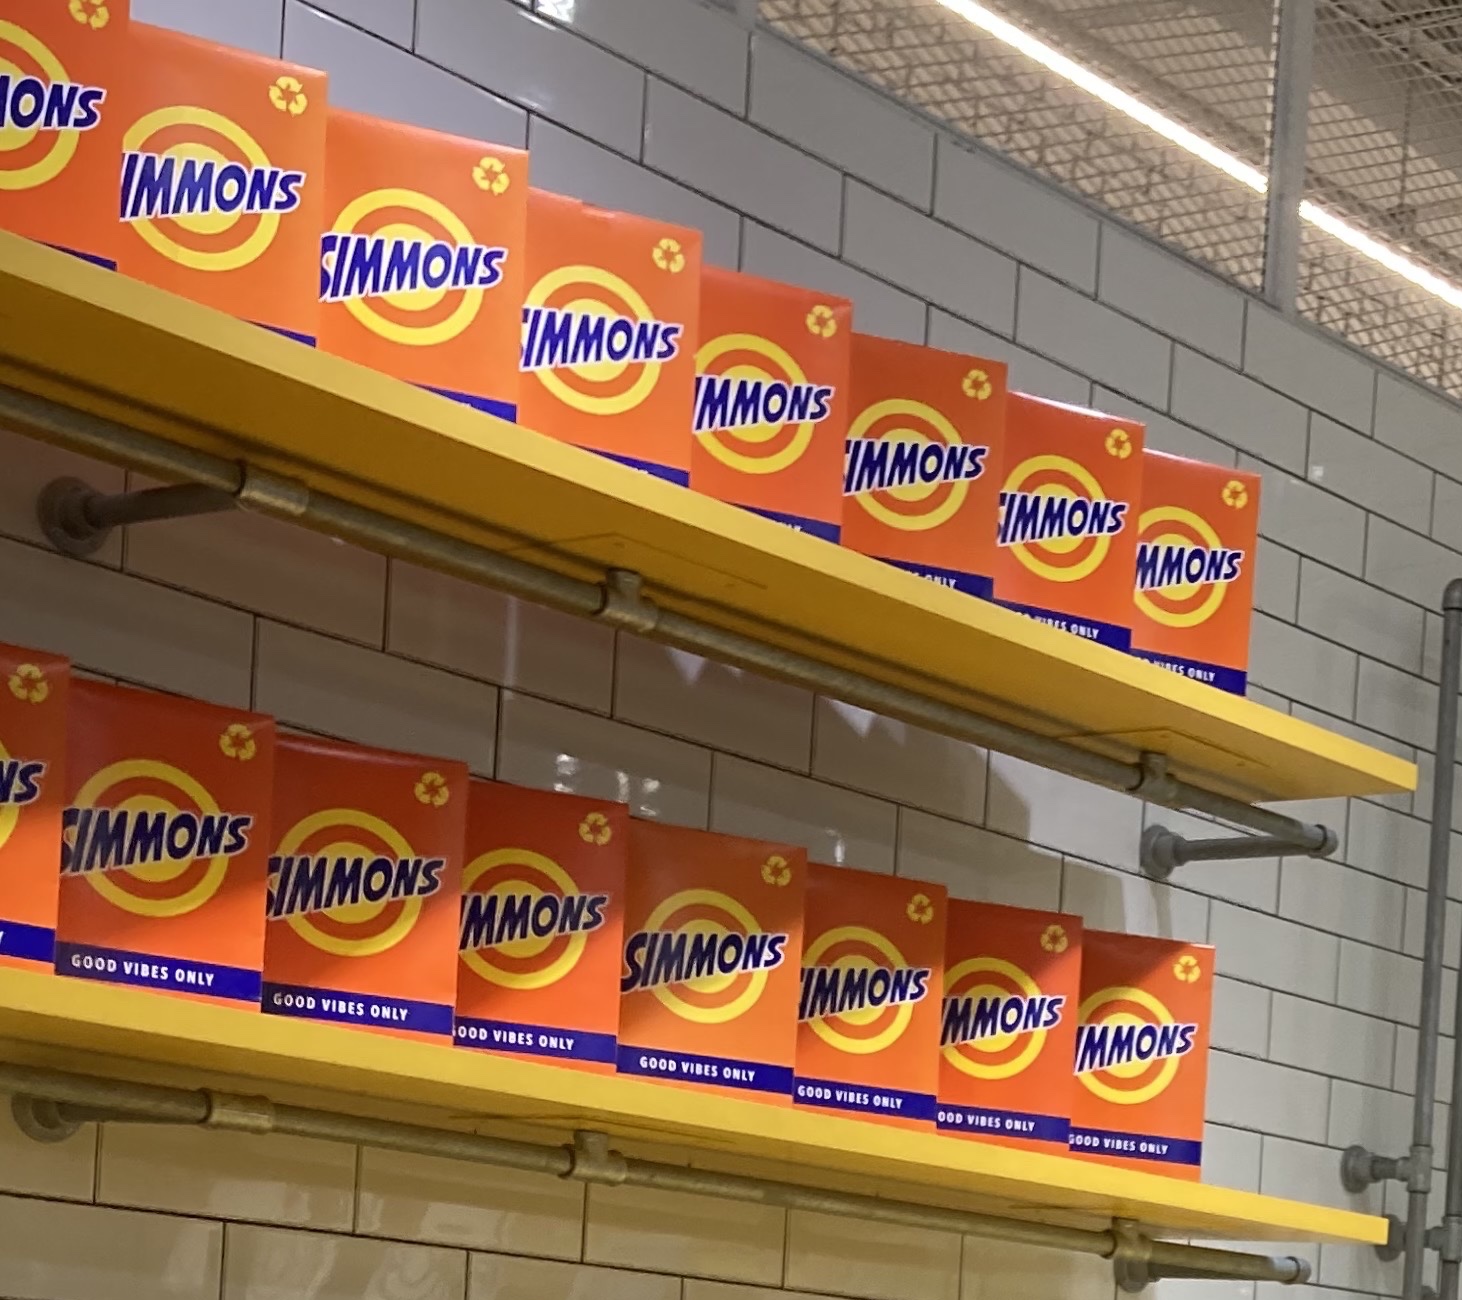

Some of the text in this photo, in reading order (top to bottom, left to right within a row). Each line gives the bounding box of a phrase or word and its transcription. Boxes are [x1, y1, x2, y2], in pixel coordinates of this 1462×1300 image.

[520, 307, 681, 369] IMMONS
[843, 440, 988, 493] IMMONS
[998, 492, 1127, 544] IMMONS
[459, 894, 607, 950] MMONS
[71, 954, 215, 986] GOOD VIBES ONLY
[620, 931, 787, 993] SIMMONS
[273, 992, 409, 1021] GOOD VIBES ONLY
[799, 967, 930, 1020] IMMONS
[493, 1029, 534, 1046] VIBES
[538, 1034, 575, 1051] ONLY
[940, 996, 1064, 1046] MMONS
[639, 1056, 756, 1083] GOOD VIBES ONLY
[797, 1085, 903, 1110] GOOD VIBES ONLY
[967, 1114, 1001, 1129] VIBES
[1005, 1119, 1035, 1132] ONLY
[1103, 1138, 1136, 1152] VIBES
[1139, 1142, 1169, 1155] ONLY
